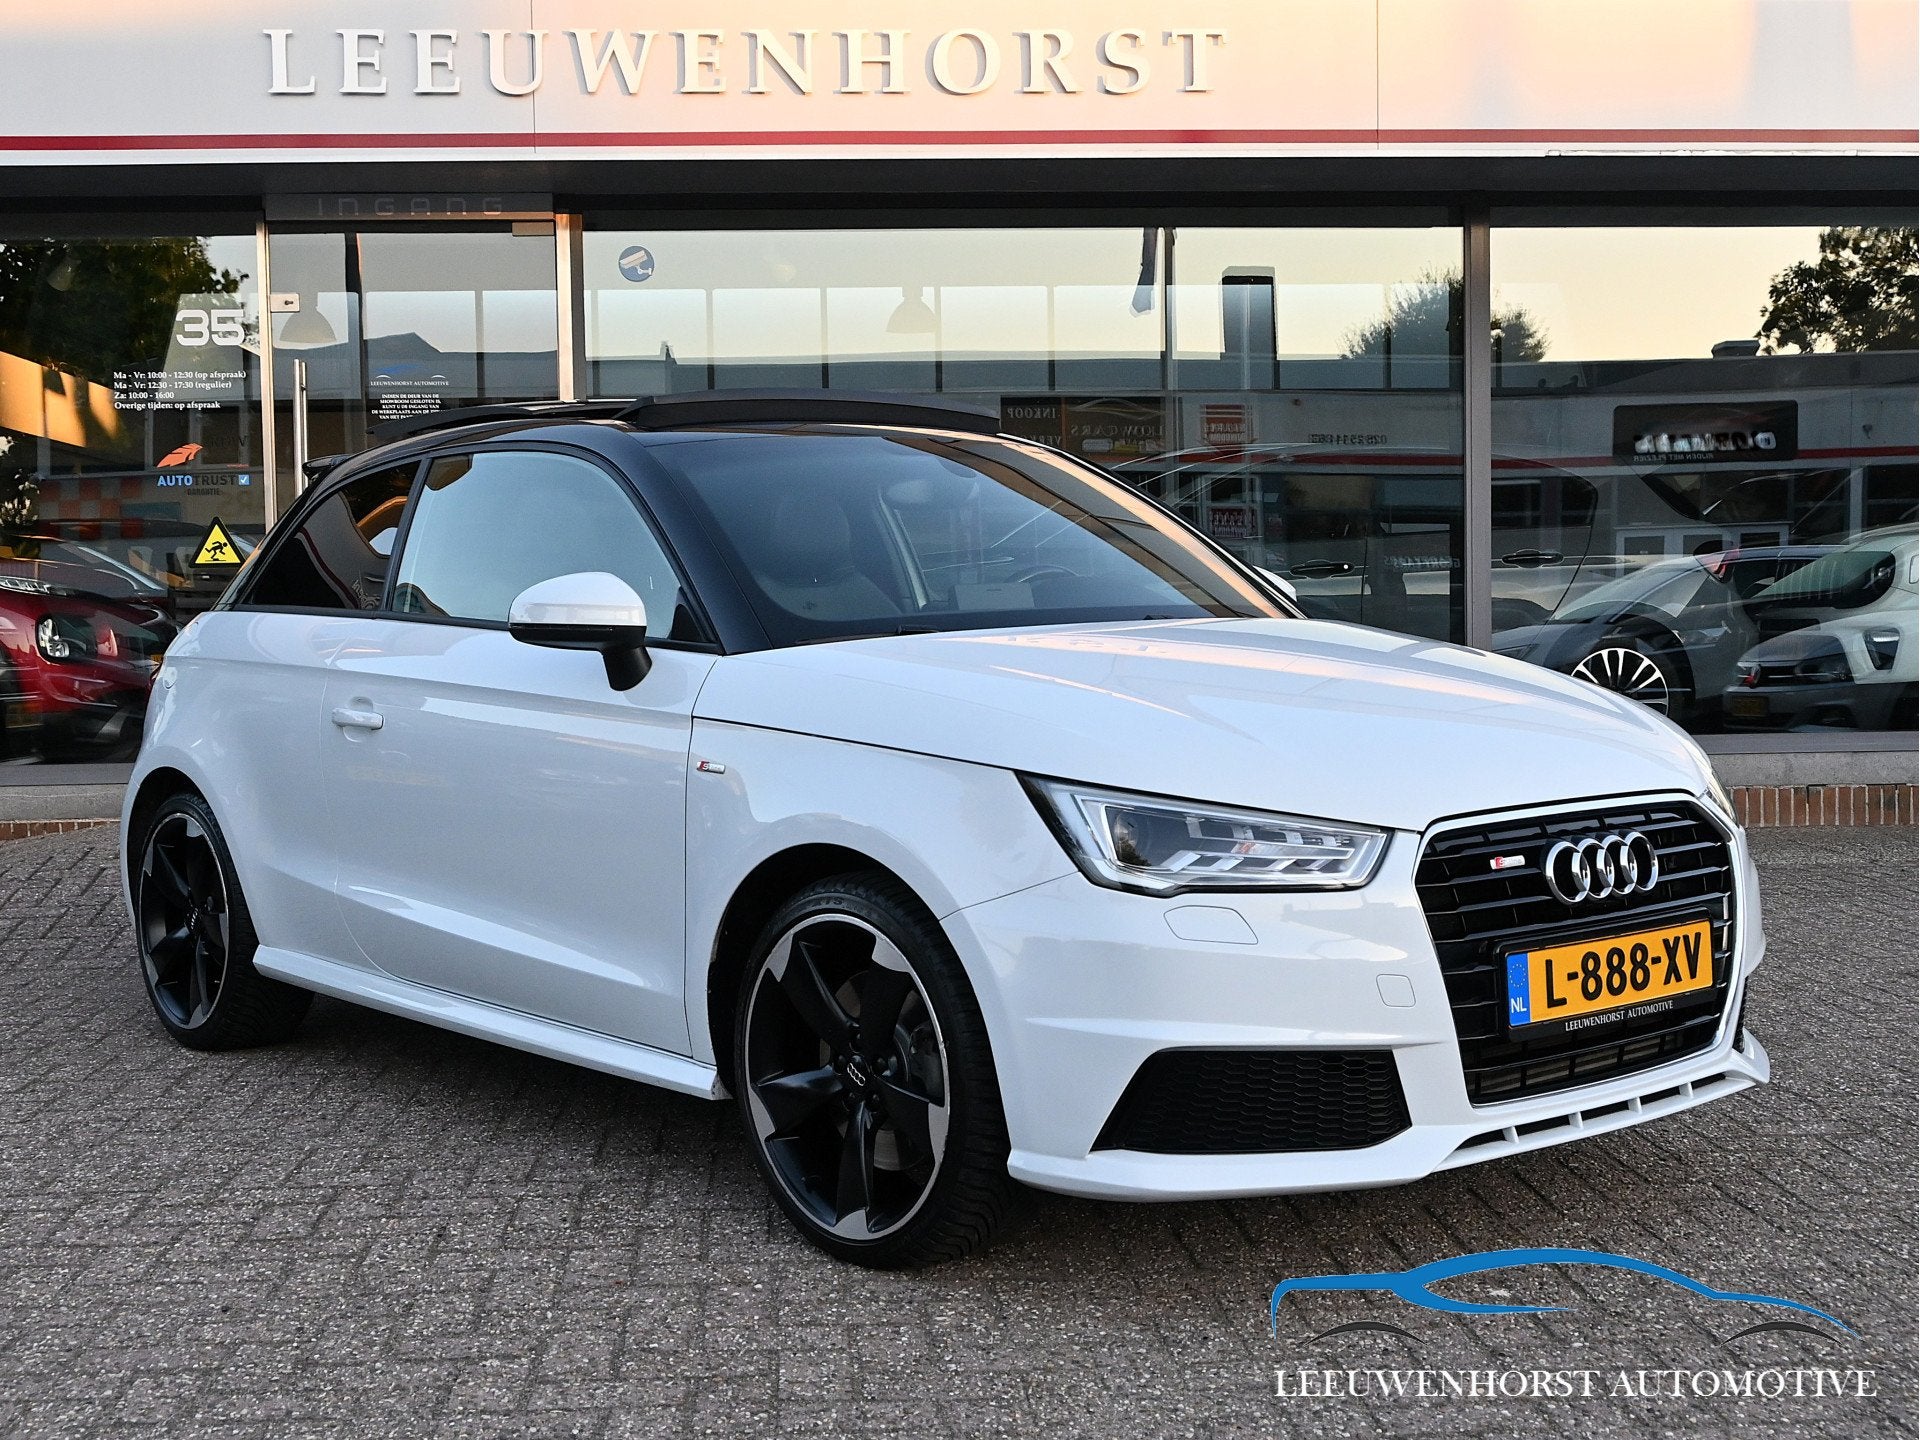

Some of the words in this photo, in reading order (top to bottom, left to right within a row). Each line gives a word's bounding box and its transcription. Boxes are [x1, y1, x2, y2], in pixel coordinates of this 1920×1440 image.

[262, 28, 1228, 97] LEEUWENHORST
[317, 197, 502, 217] INGANG
[175, 308, 246, 347] 35
[113, 371, 127, 379] Ma
[133, 371, 146, 379] Vr:
[147, 371, 168, 379] 10:00
[174, 371, 194, 379] 12:30
[194, 371, 208, 380] (op
[209, 370, 247, 380] afspraak)
[114, 381, 128, 389] Ma
[134, 381, 147, 389] Vr:
[148, 381, 168, 389] 12:30
[174, 381, 194, 389] 17:30
[195, 380, 232, 390] (regulier)
[114, 391, 127, 399] Za:
[128, 391, 149, 399] 10:00
[154, 391, 175, 399] 16:00
[114, 401, 146, 411] Overige
[147, 401, 173, 411] tijden:
[174, 402, 186, 411] op
[186, 400, 221, 411] afspraak
[1544, 931, 1702, 1009] L-888-XV
[1510, 996, 1528, 1014] NL
[1564, 1010, 1626, 1032] LEEUWENHORST
[1627, 999, 1674, 1020] AUTOMOTIVE
